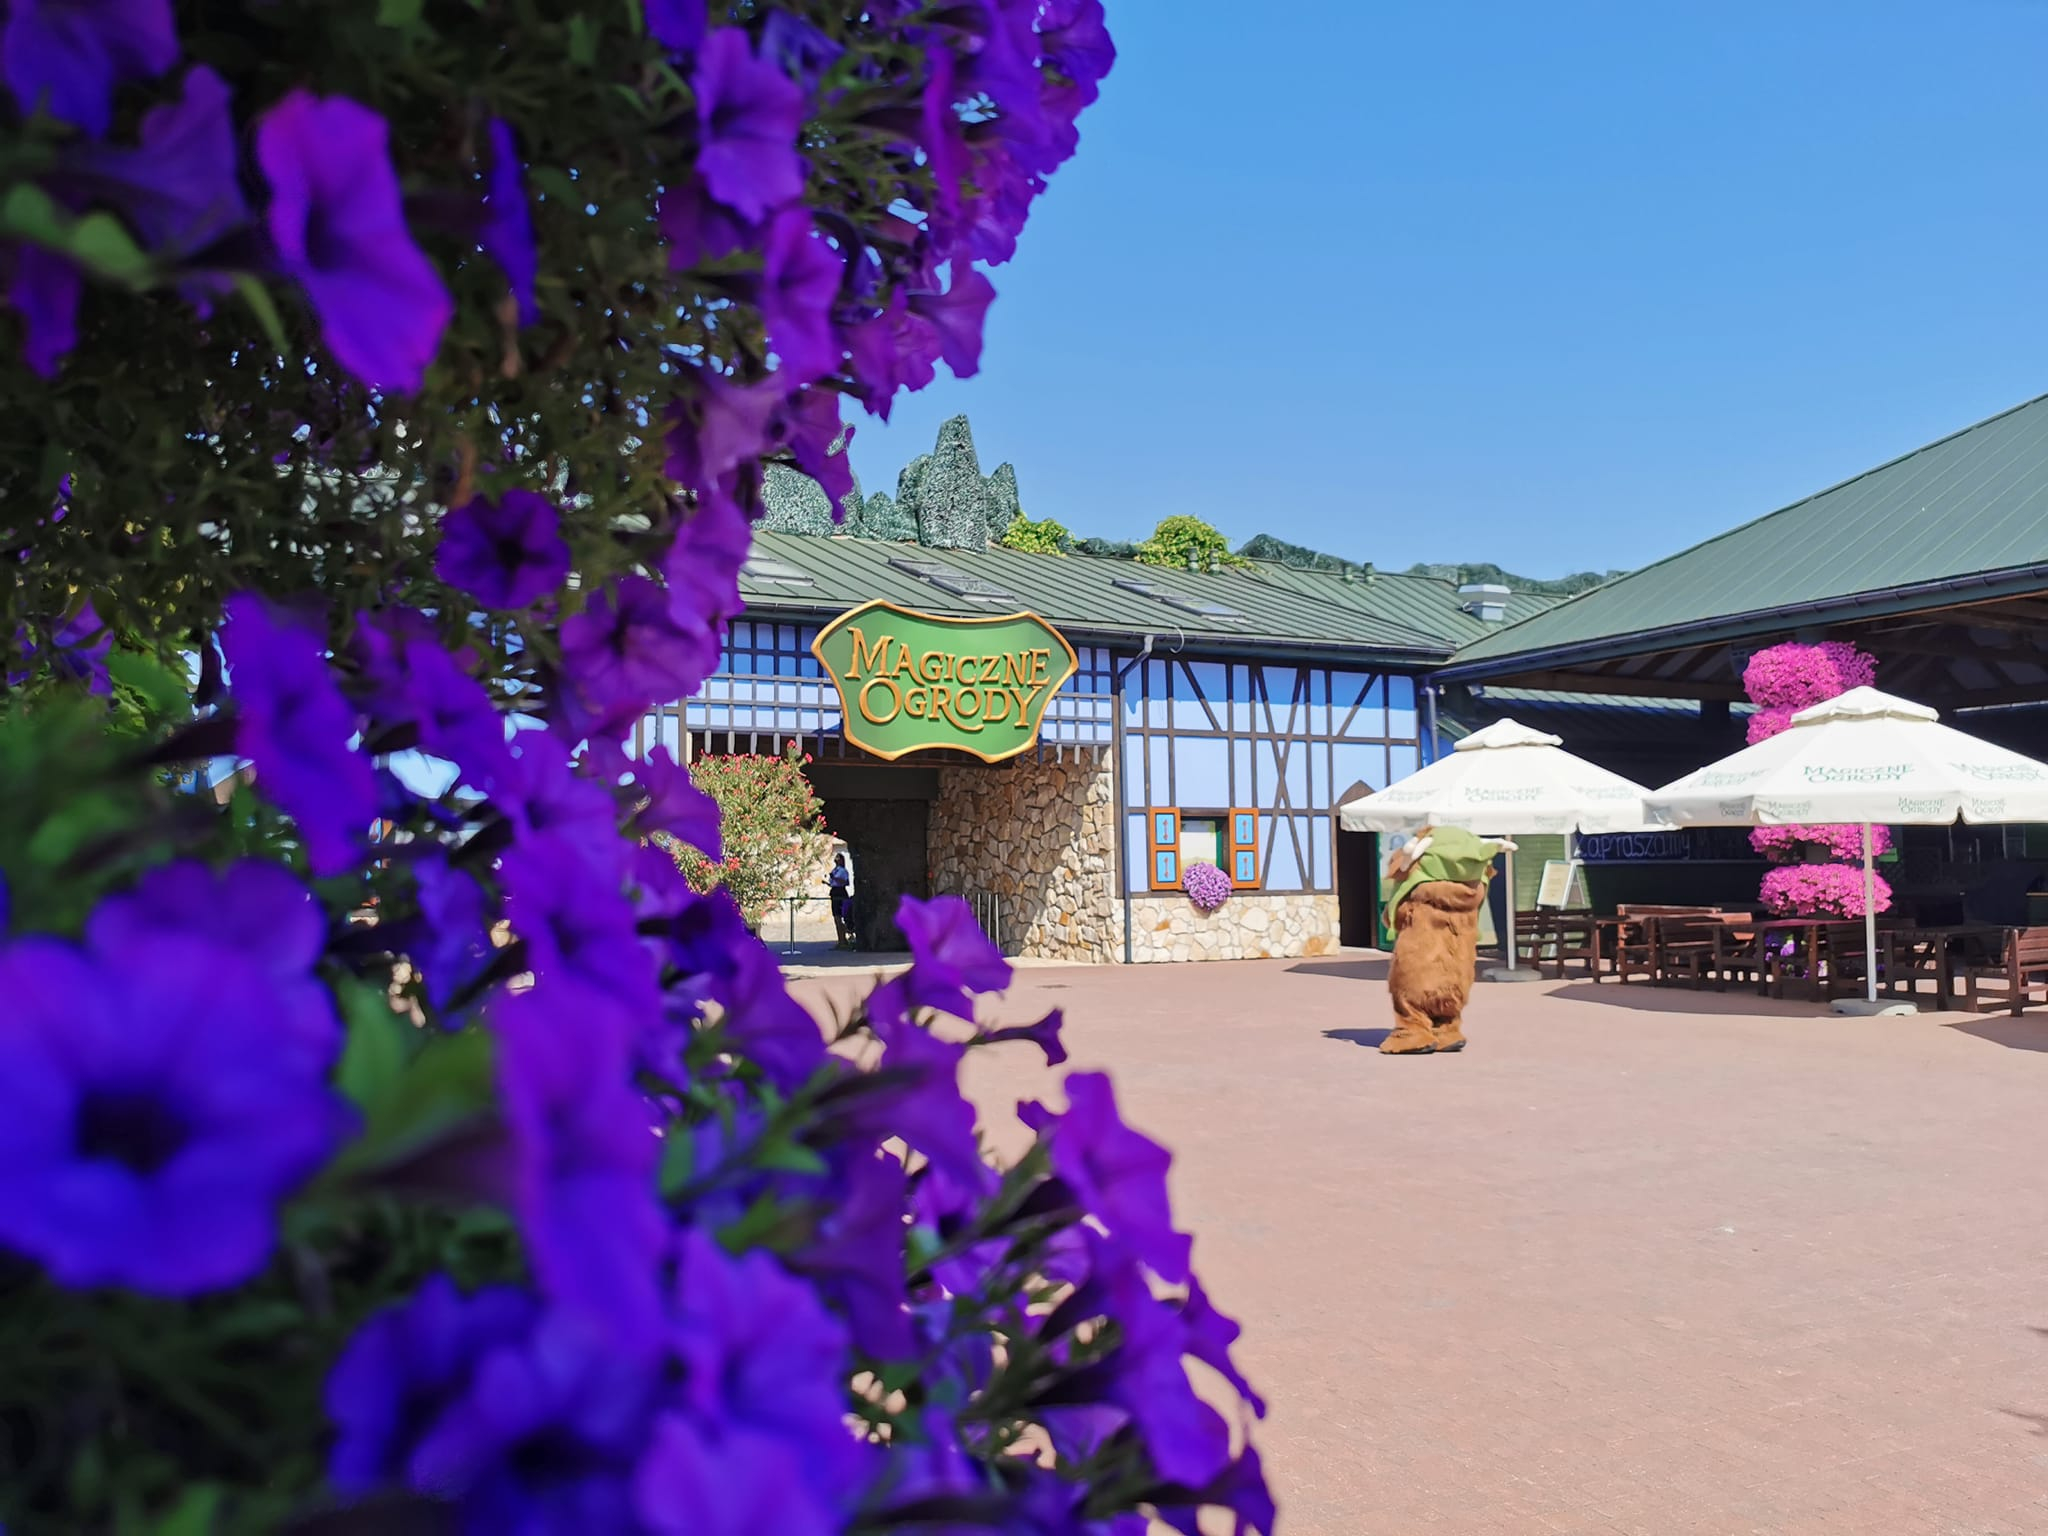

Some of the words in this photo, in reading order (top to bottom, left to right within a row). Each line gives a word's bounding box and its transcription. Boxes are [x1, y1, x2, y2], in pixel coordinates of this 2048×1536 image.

[844, 626, 1051, 687] MAGICZNE
[859, 677, 1043, 732] OGRODY
[1803, 763, 1915, 776] MAGICZNE
[1808, 773, 1902, 784] OGRODY
